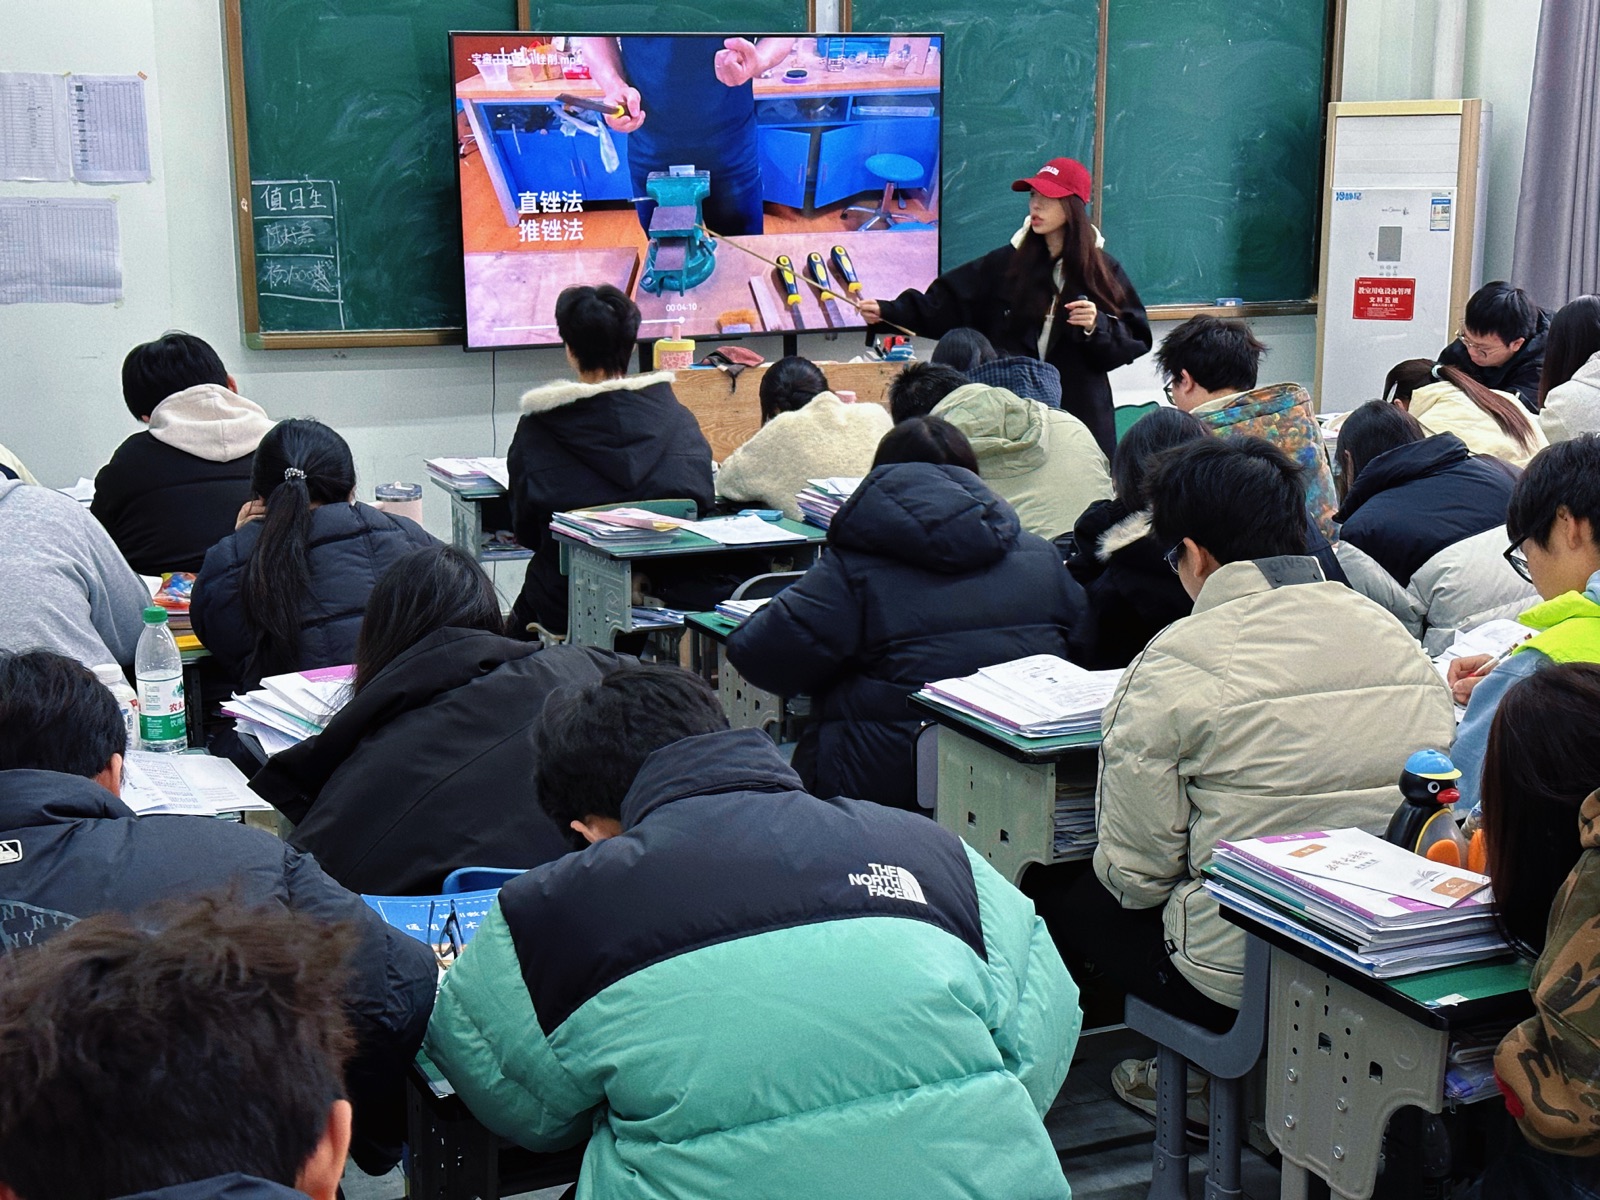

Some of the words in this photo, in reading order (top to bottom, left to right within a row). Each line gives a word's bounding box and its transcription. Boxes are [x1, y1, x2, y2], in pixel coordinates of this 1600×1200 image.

[260, 185, 327, 211] 值日生
[518, 190, 583, 214] 直锉法
[518, 218, 584, 242] 推锉法
[665, 302, 698, 312] 00:04:10
[867, 862, 898, 878] THE
[848, 873, 900, 889] NORTH
[867, 885, 905, 900] FACE
